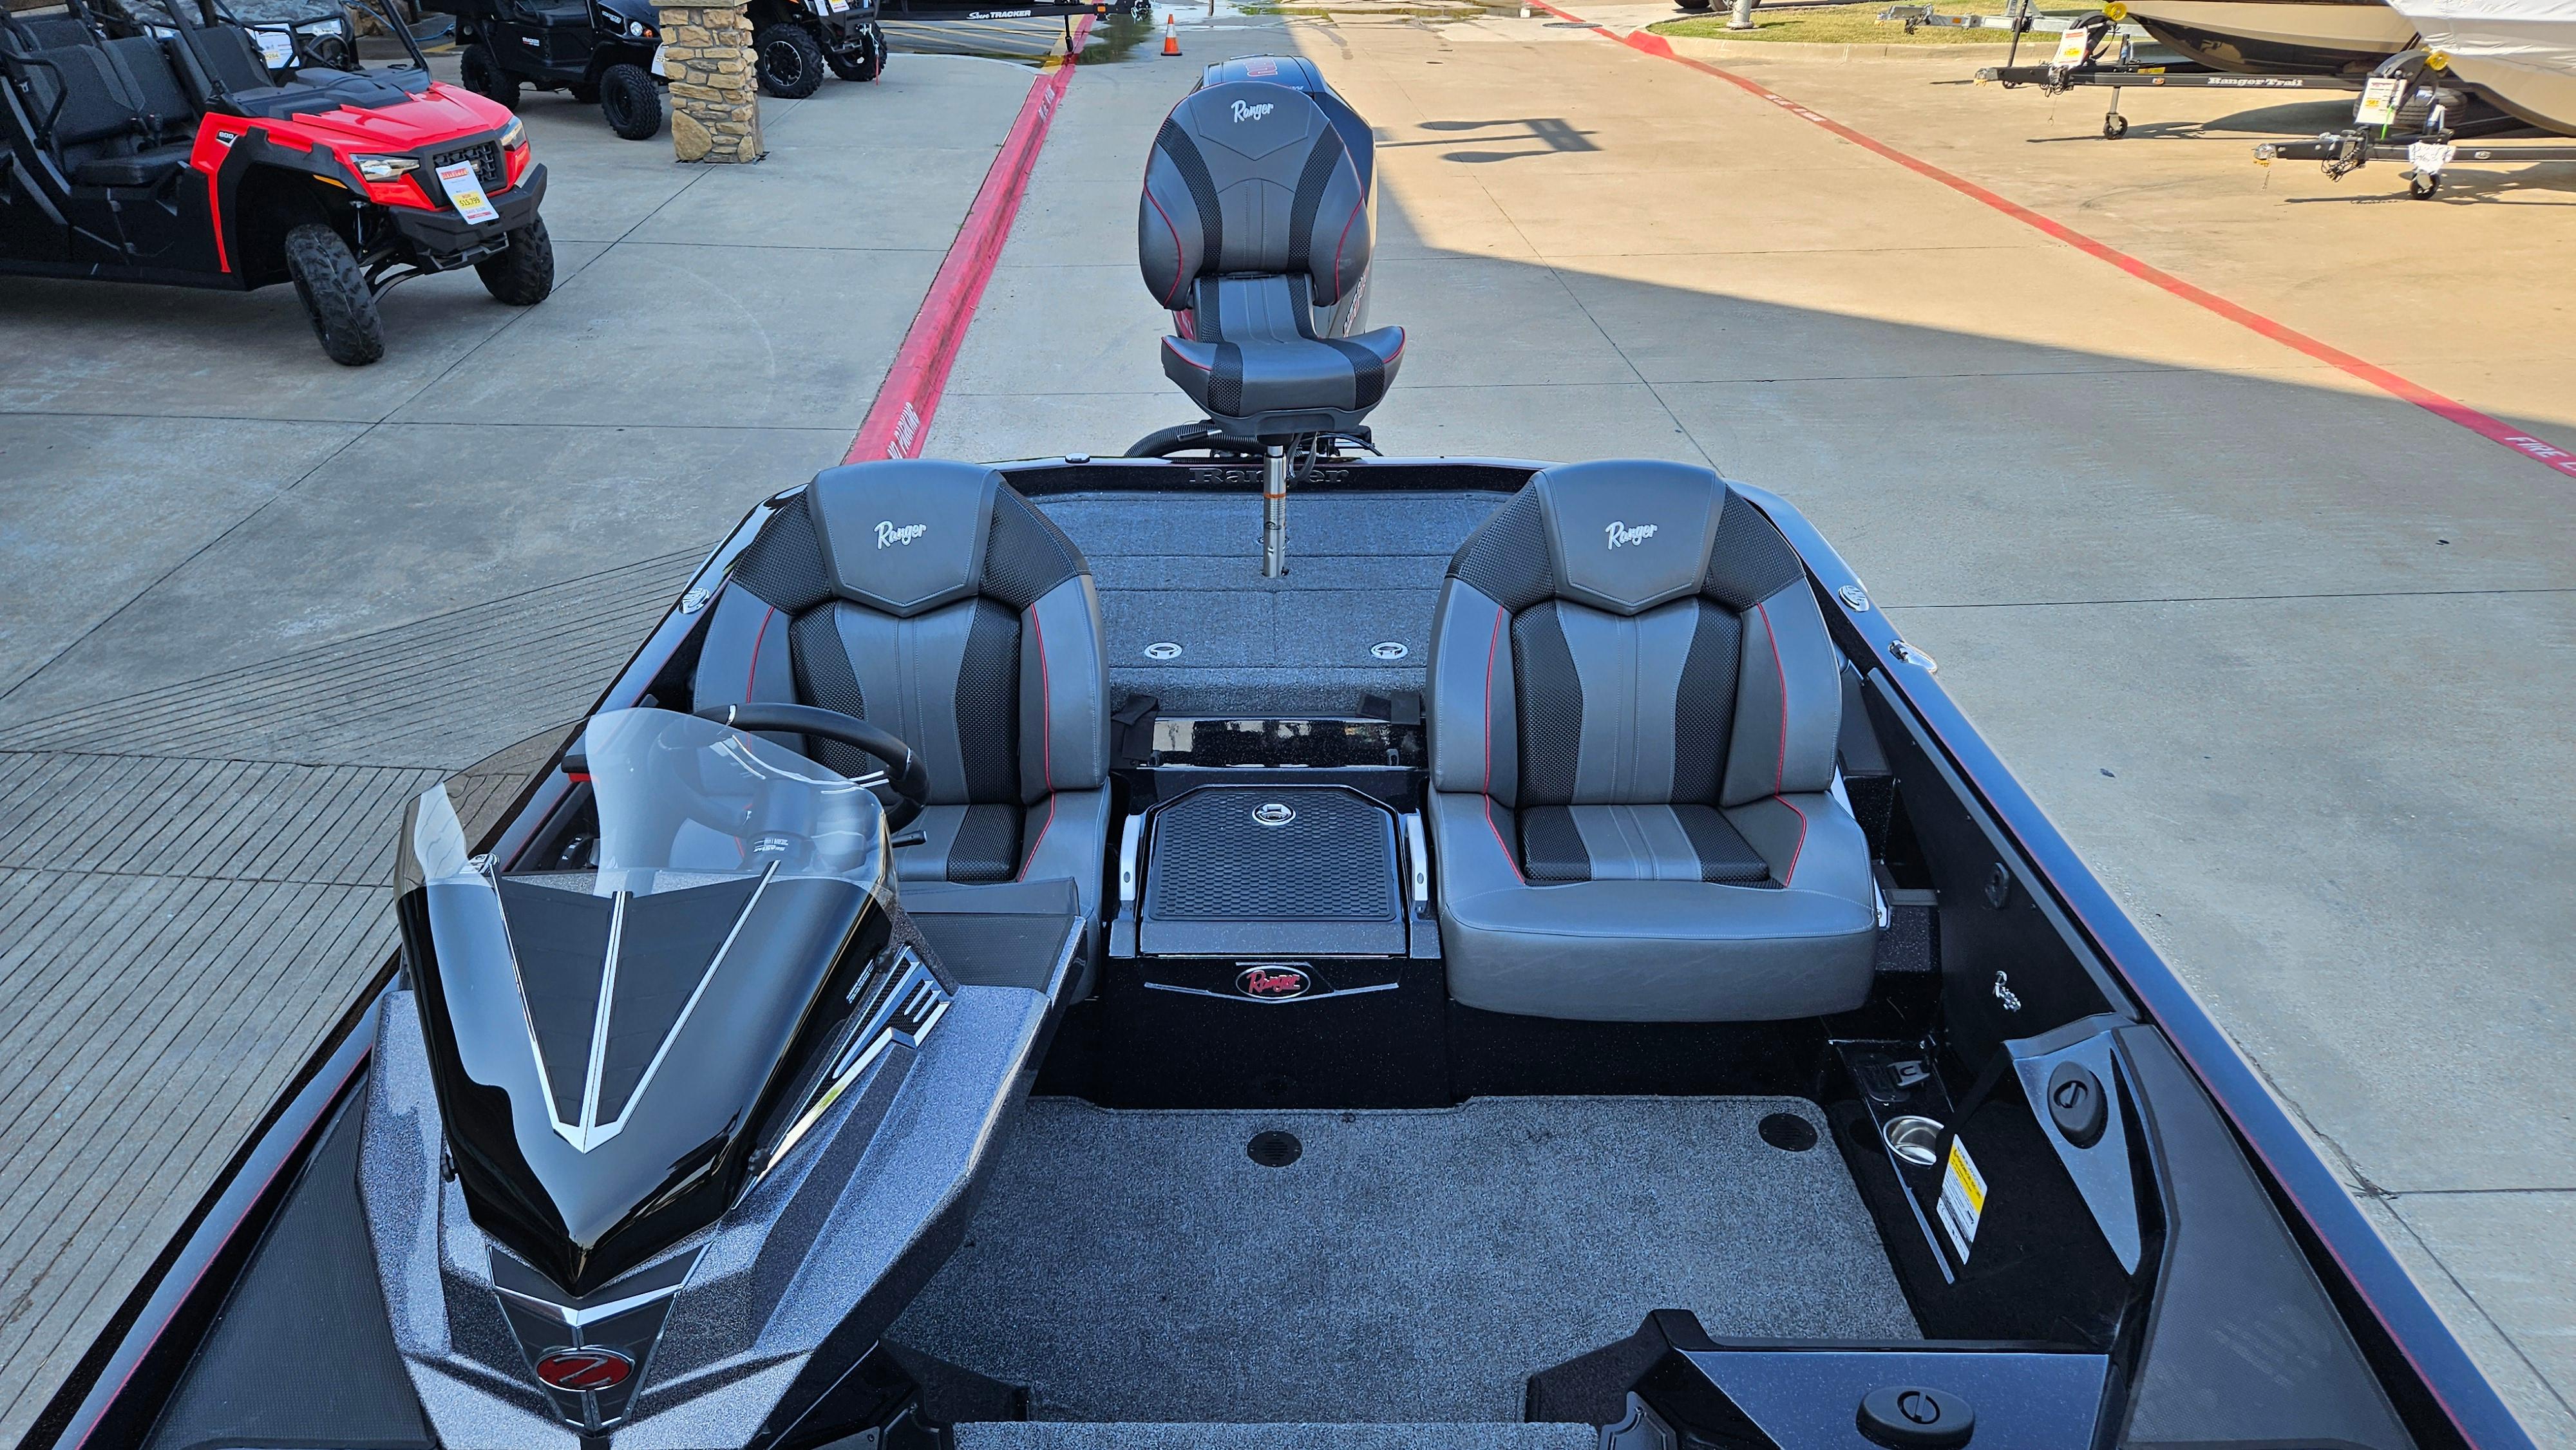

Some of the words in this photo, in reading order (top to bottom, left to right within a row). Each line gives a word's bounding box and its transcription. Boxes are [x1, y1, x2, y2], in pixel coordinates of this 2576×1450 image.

[2207, 77, 2264, 86] Ranger
[1231, 100, 1274, 123] Ranger
[894, 401, 920, 456] PARKING
[2503, 437, 2571, 458] FIRE
[1189, 467, 1349, 483] Raner
[874, 520, 927, 549] Ranger
[1605, 521, 1658, 550] Ranger
[1246, 970, 1301, 993] Ranger
